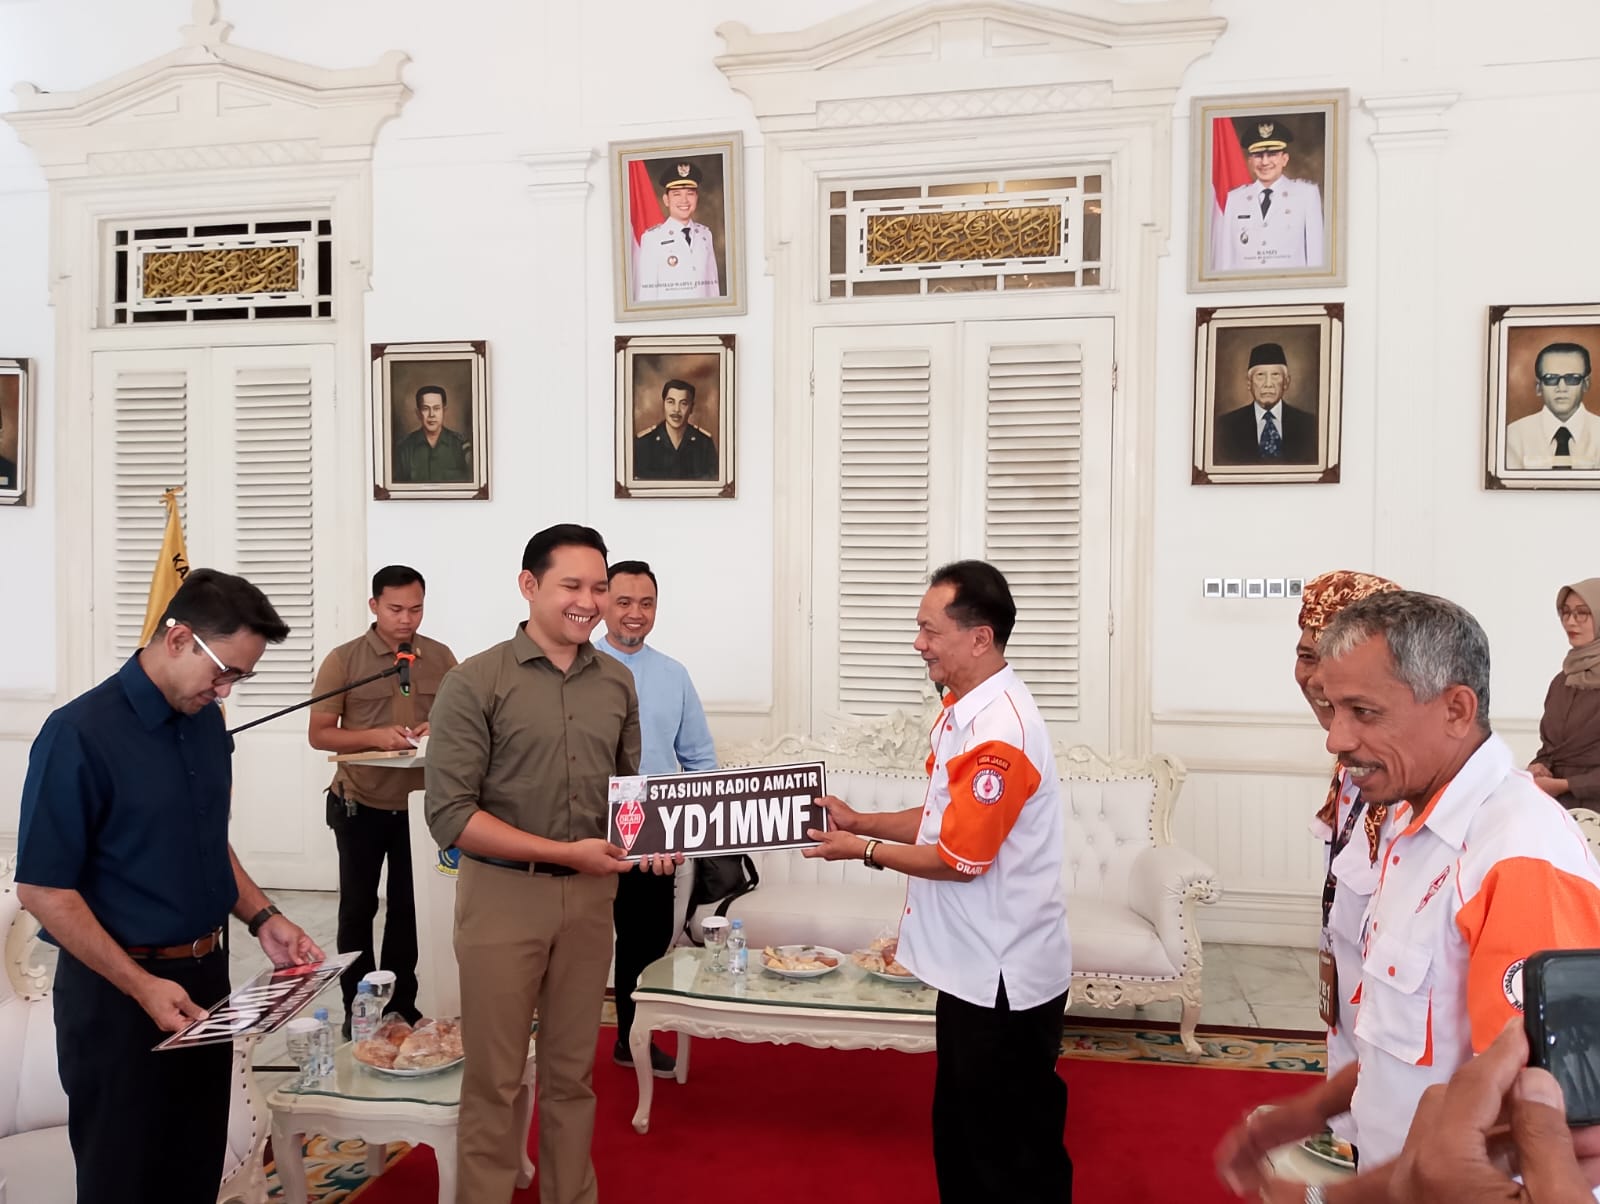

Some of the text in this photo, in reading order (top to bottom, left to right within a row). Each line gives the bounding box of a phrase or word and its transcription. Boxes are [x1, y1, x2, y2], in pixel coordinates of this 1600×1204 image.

[650, 771, 818, 800] STASIUN RADIO AMATIR
[658, 795, 811, 849] YD1MWF
